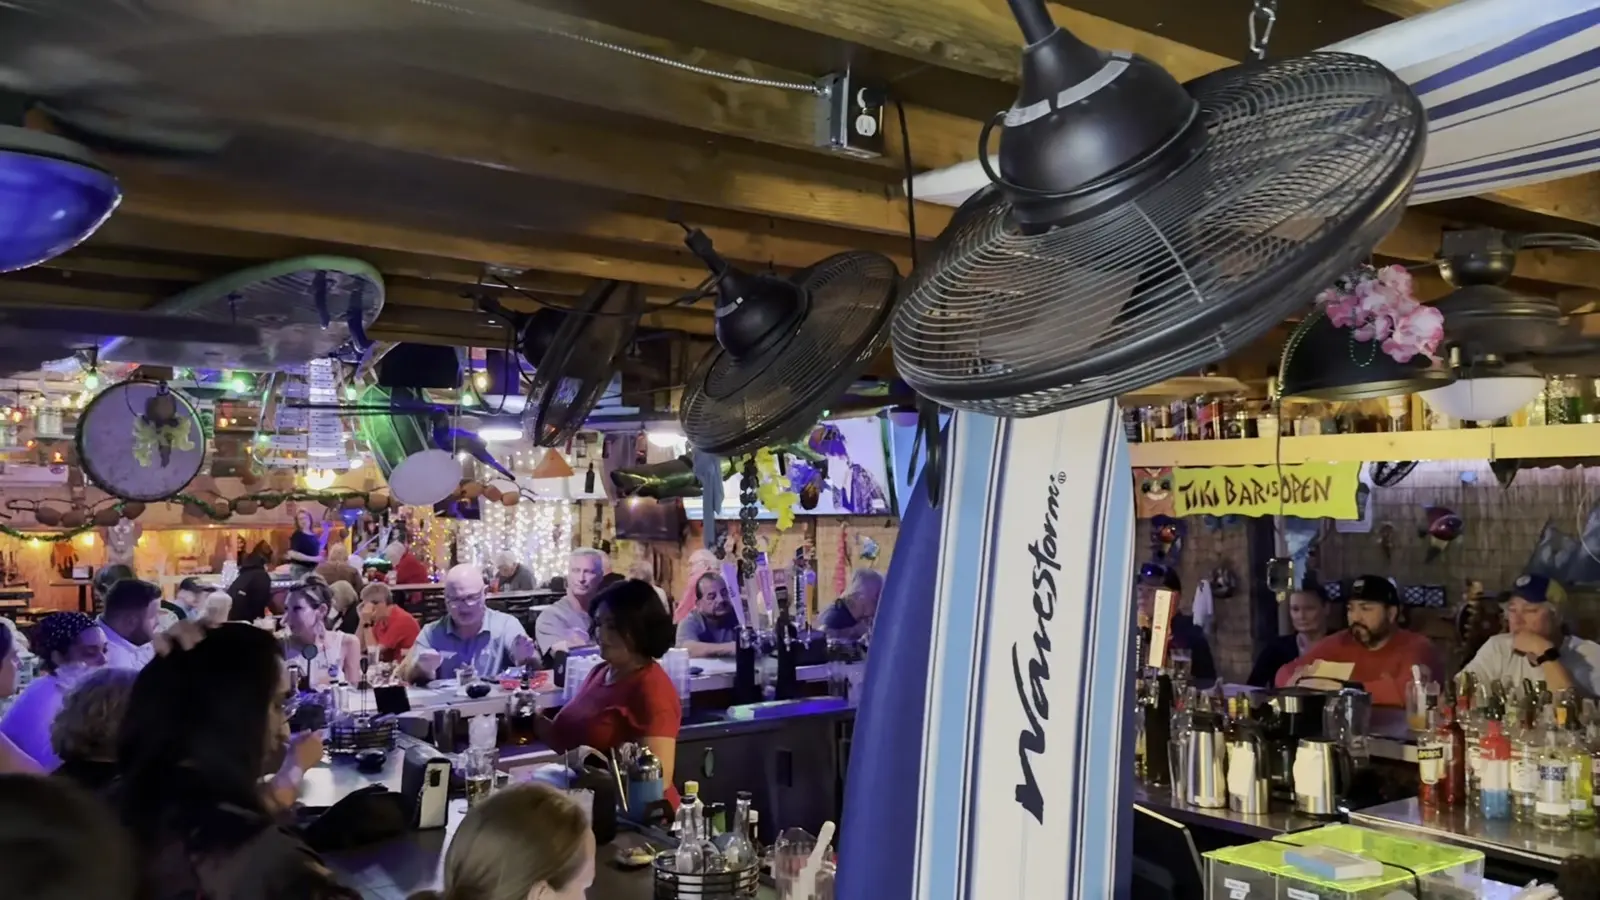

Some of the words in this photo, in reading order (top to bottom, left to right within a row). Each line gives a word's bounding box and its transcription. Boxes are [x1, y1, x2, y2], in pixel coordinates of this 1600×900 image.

[1178, 480, 1220, 510] TIKI
[1224, 474, 1267, 508] BAR
[1280, 473, 1333, 507] OPEN
